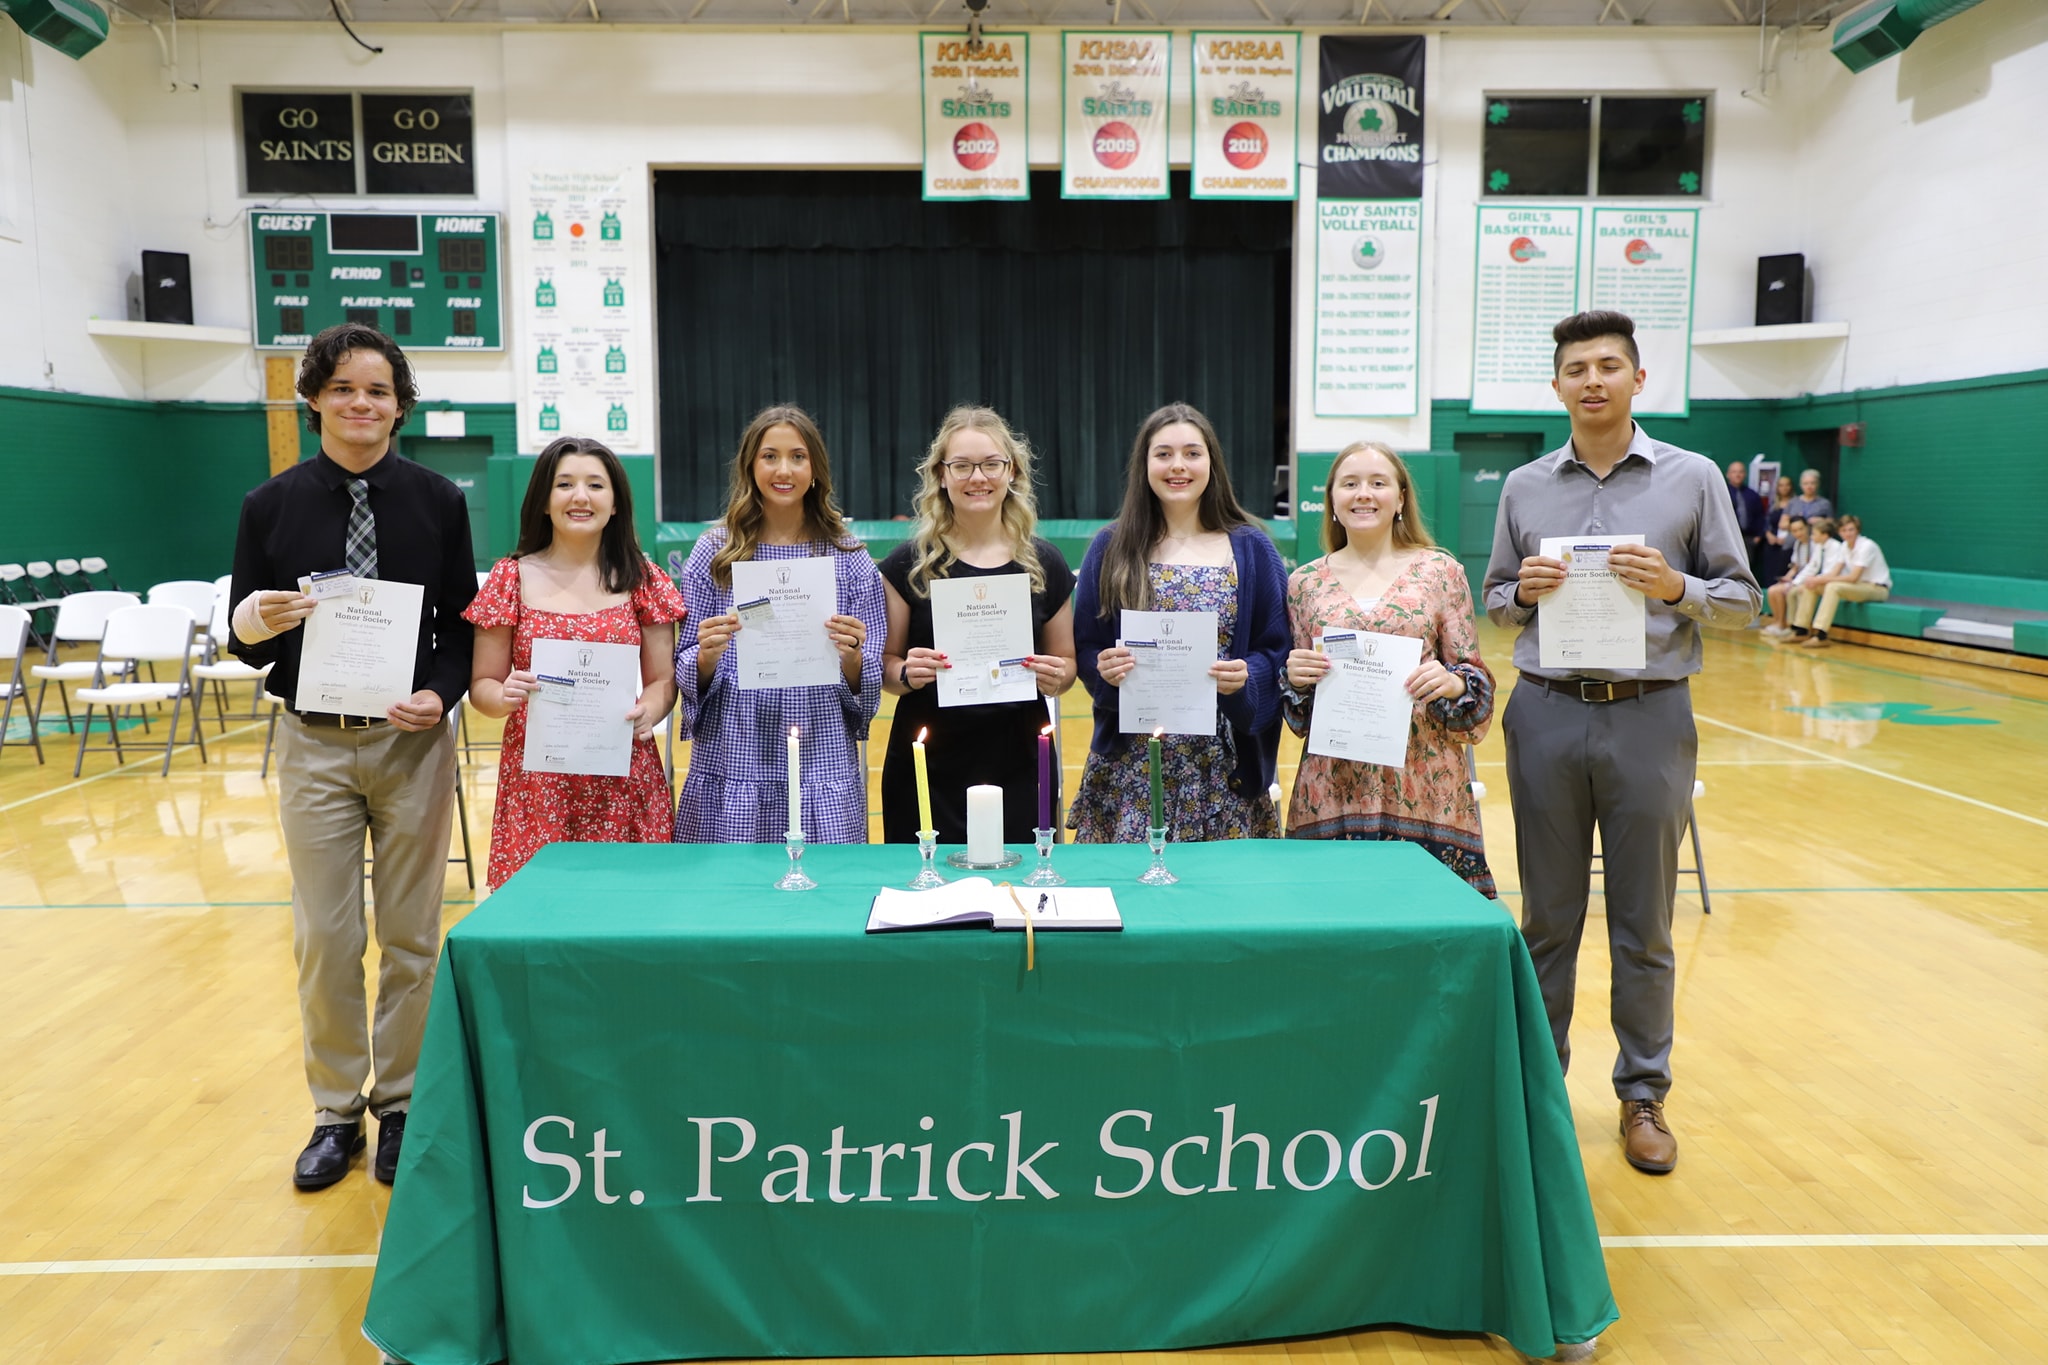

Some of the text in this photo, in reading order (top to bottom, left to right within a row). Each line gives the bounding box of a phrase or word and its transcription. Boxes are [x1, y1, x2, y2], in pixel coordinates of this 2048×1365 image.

[937, 42, 1013, 61] KHSAA
[1210, 40, 1284, 61] KHSAA
[967, 66, 1019, 78] District
[1082, 97, 1152, 116] SAINTS
[1212, 97, 1281, 116] SAINTS
[1321, 83, 1420, 117] VOLLEYBALL
[941, 99, 1011, 118] SAINTS
[278, 108, 318, 129] GO
[393, 109, 440, 130] GO
[260, 140, 352, 161] SAINTS
[957, 140, 996, 154] 2002
[1096, 139, 1136, 153] 2009
[1228, 138, 1263, 153] 2011
[372, 142, 465, 163] GREEN
[1323, 144, 1420, 163] CHAMPIONS
[933, 178, 1020, 190] CHAMPIONS
[1073, 176, 1160, 189] CHAMPIONS
[1202, 177, 1287, 190] CHAMPIONS
[1321, 205, 1418, 218] LADY SAINTS
[1508, 212, 1552, 223] GIRL'S
[258, 216, 487, 233] GUEST HOME
[1322, 219, 1416, 231] VOLLEYBALL
[1623, 214, 1667, 225] GIRL'S
[1484, 225, 1574, 236] BASKETBALL
[1600, 227, 1689, 238] BASKETBALL
[331, 267, 382, 280] PERIOD
[274, 296, 309, 306] FOULS
[341, 297, 415, 307] PLAYER-FOUL
[447, 297, 481, 308] FOULS
[273, 335, 312, 345] POINTS
[445, 336, 485, 347] POINTS
[1590, 571, 1618, 579] Society
[768, 587, 801, 595] National
[784, 593, 811, 602] Society
[347, 606, 382, 617] National
[966, 603, 997, 611] National
[981, 609, 1008, 617] Society
[335, 612, 393, 626] Honor Society
[1343, 663, 1393, 676] Honor Society
[1353, 658, 1384, 668] National
[567, 670, 601, 678] National
[582, 677, 611, 686] Society
[522, 1093, 1440, 1210] St. Patrick School
